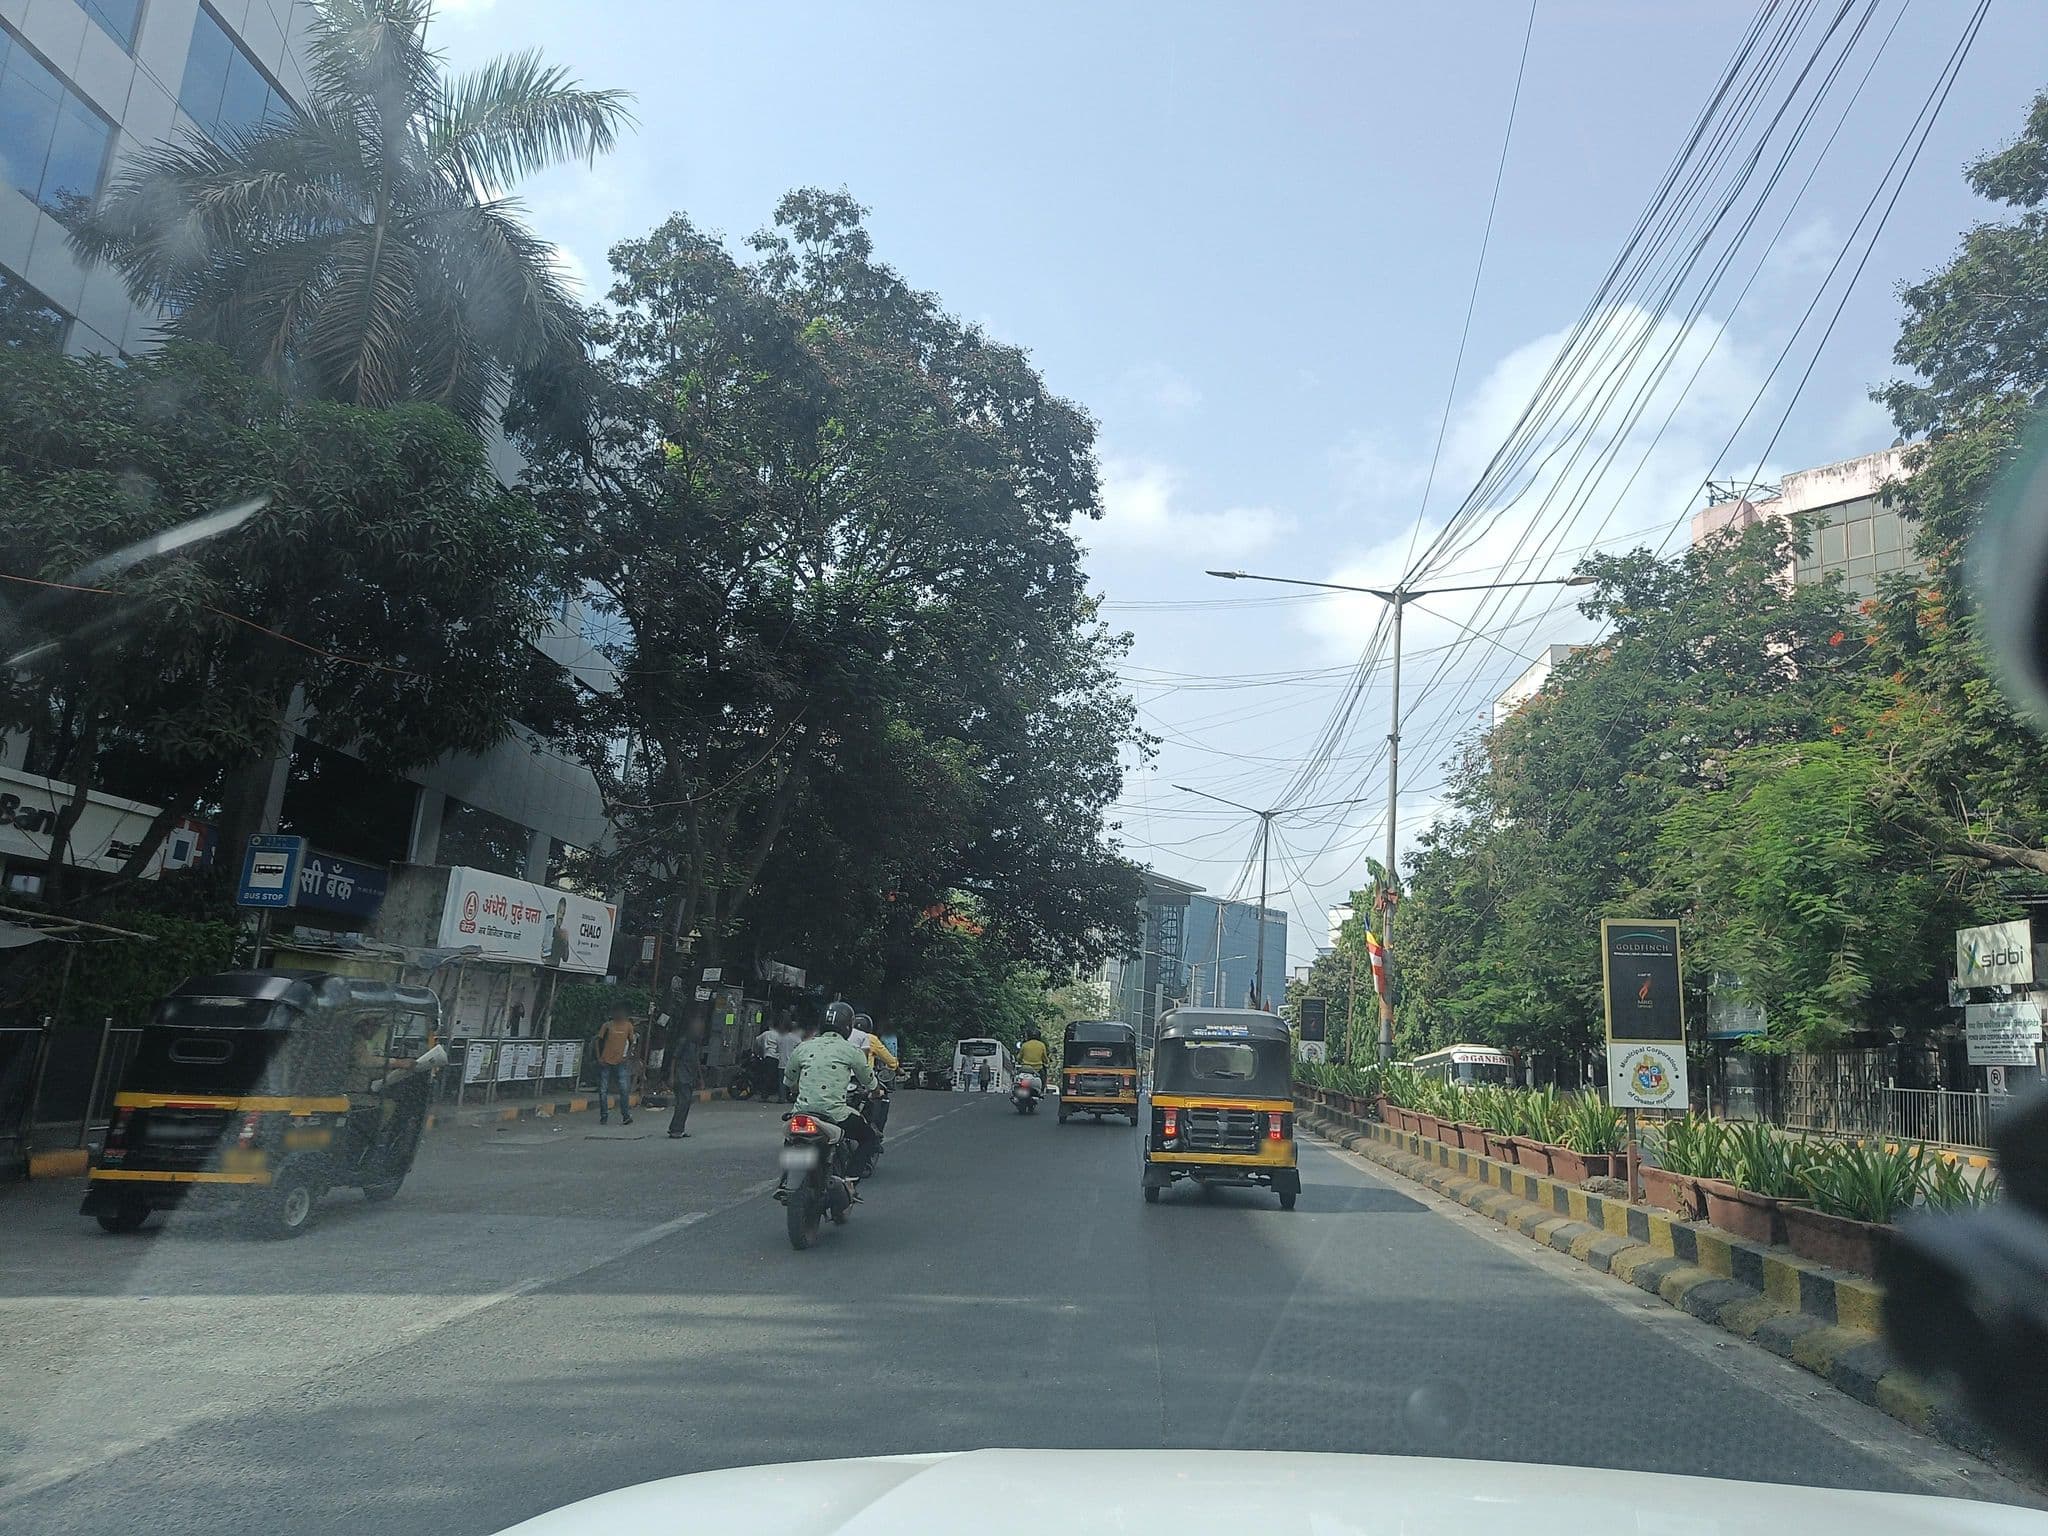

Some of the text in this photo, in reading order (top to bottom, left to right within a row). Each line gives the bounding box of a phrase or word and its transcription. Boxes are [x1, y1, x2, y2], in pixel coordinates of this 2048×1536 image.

[326, 864, 355, 901] बँक
[243, 892, 284, 901] BUS STOP
[525, 907, 542, 924] चला
[580, 923, 601, 939] CHALO
[1616, 943, 1669, 952] GOLDFINCH
[1981, 945, 2023, 968] sidbi
[1619, 1046, 1679, 1072] Municipal Corporation
